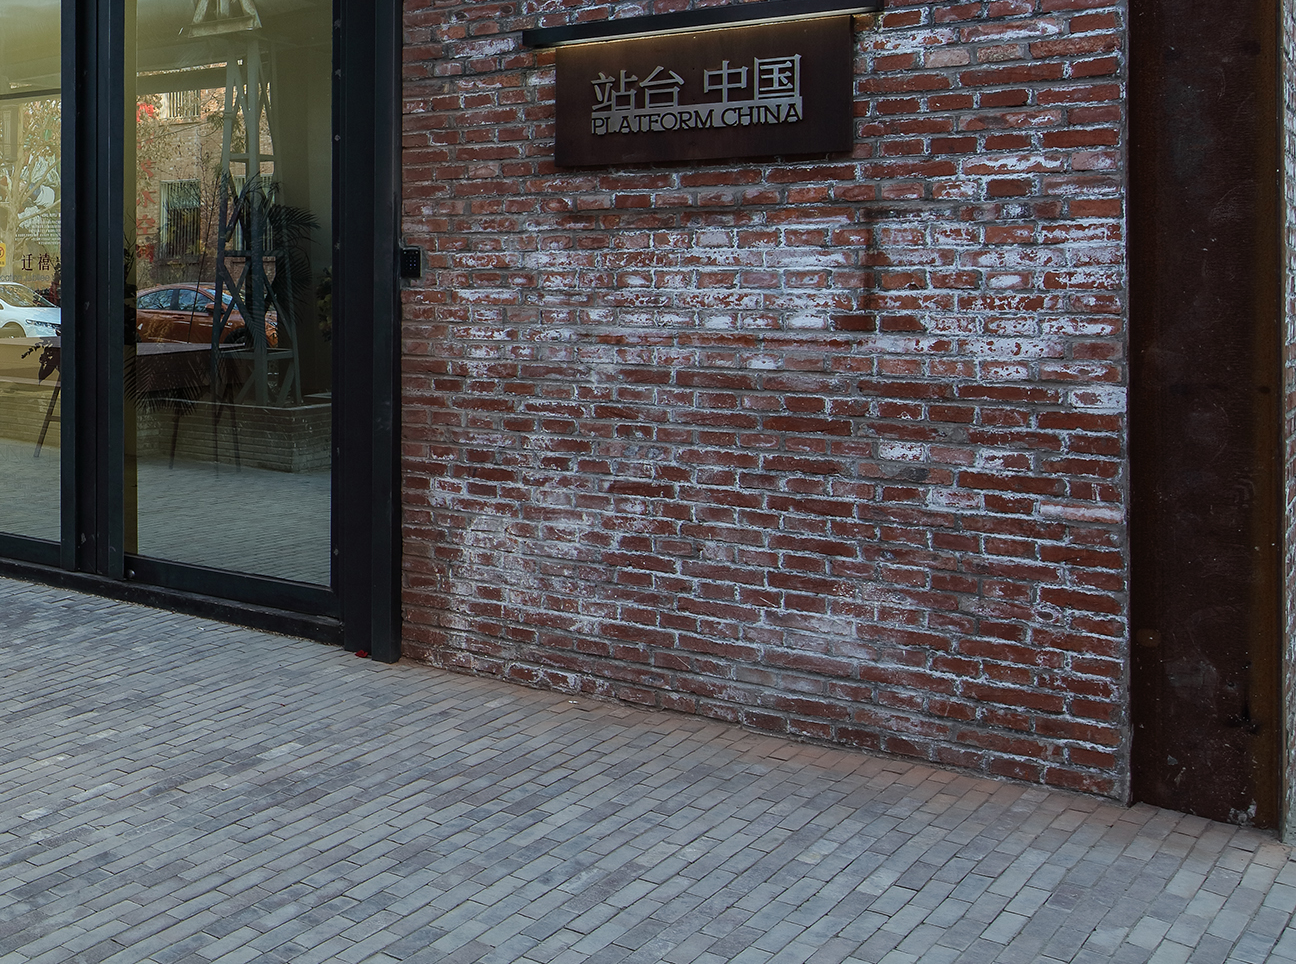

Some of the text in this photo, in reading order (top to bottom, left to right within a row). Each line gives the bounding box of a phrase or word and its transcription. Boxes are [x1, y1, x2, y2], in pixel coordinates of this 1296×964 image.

[590, 53, 802, 111] 站台 中国
[590, 102, 803, 135] PLATFORM CHINA
